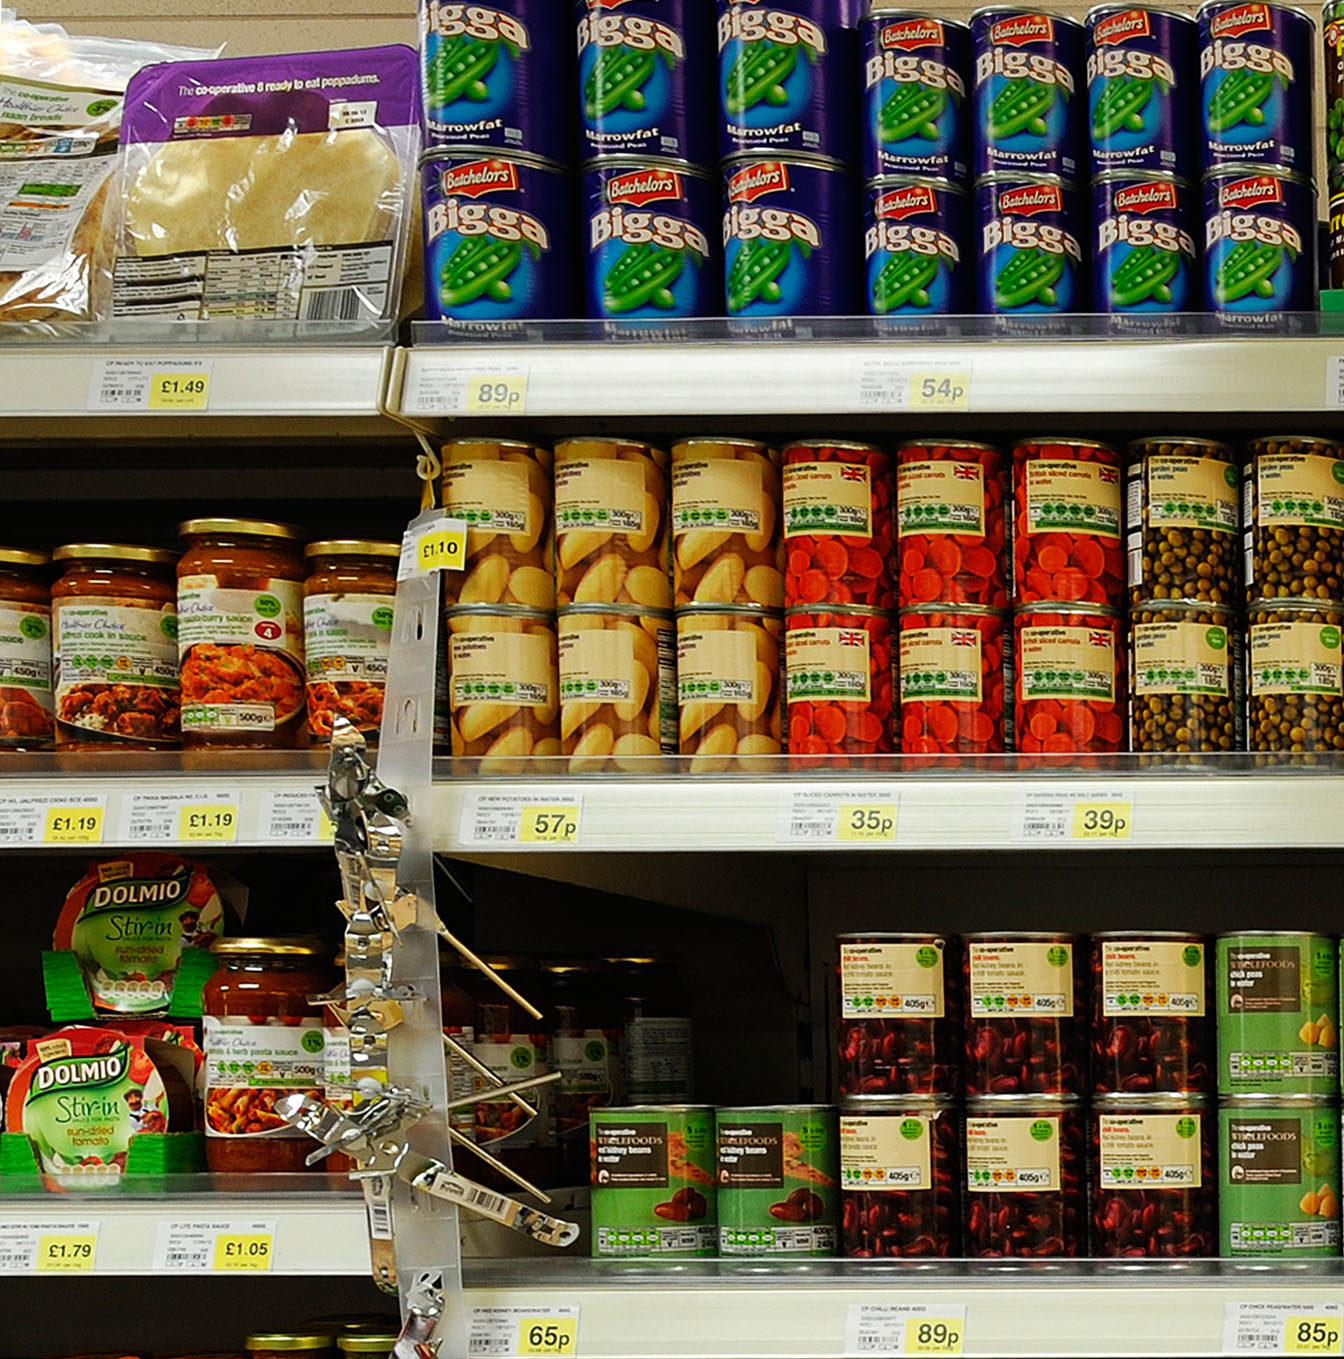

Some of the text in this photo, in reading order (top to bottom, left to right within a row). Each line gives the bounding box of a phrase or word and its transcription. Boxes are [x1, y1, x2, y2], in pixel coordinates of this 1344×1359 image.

[179, 75, 379, 96] The co-operative 8 ready to eat poppadums.
[878, 151, 949, 166] Marrowfat
[444, 166, 514, 193] Batchelors
[426, 201, 548, 250] Bigga
[162, 379, 205, 396] £1.49
[422, 541, 459, 560] £1.10
[239, 712, 263, 723] 500g
[189, 813, 232, 827] £1.19
[535, 813, 576, 839] 57p
[38, 1056, 121, 1089] DOLMIO
[55, 1096, 120, 1123] Stir-in
[66, 1126, 115, 1137] sun-dried
[71, 1136, 110, 1147] tomato
[48, 1244, 91, 1259] £1.79
[528, 1326, 570, 1350] 65p
